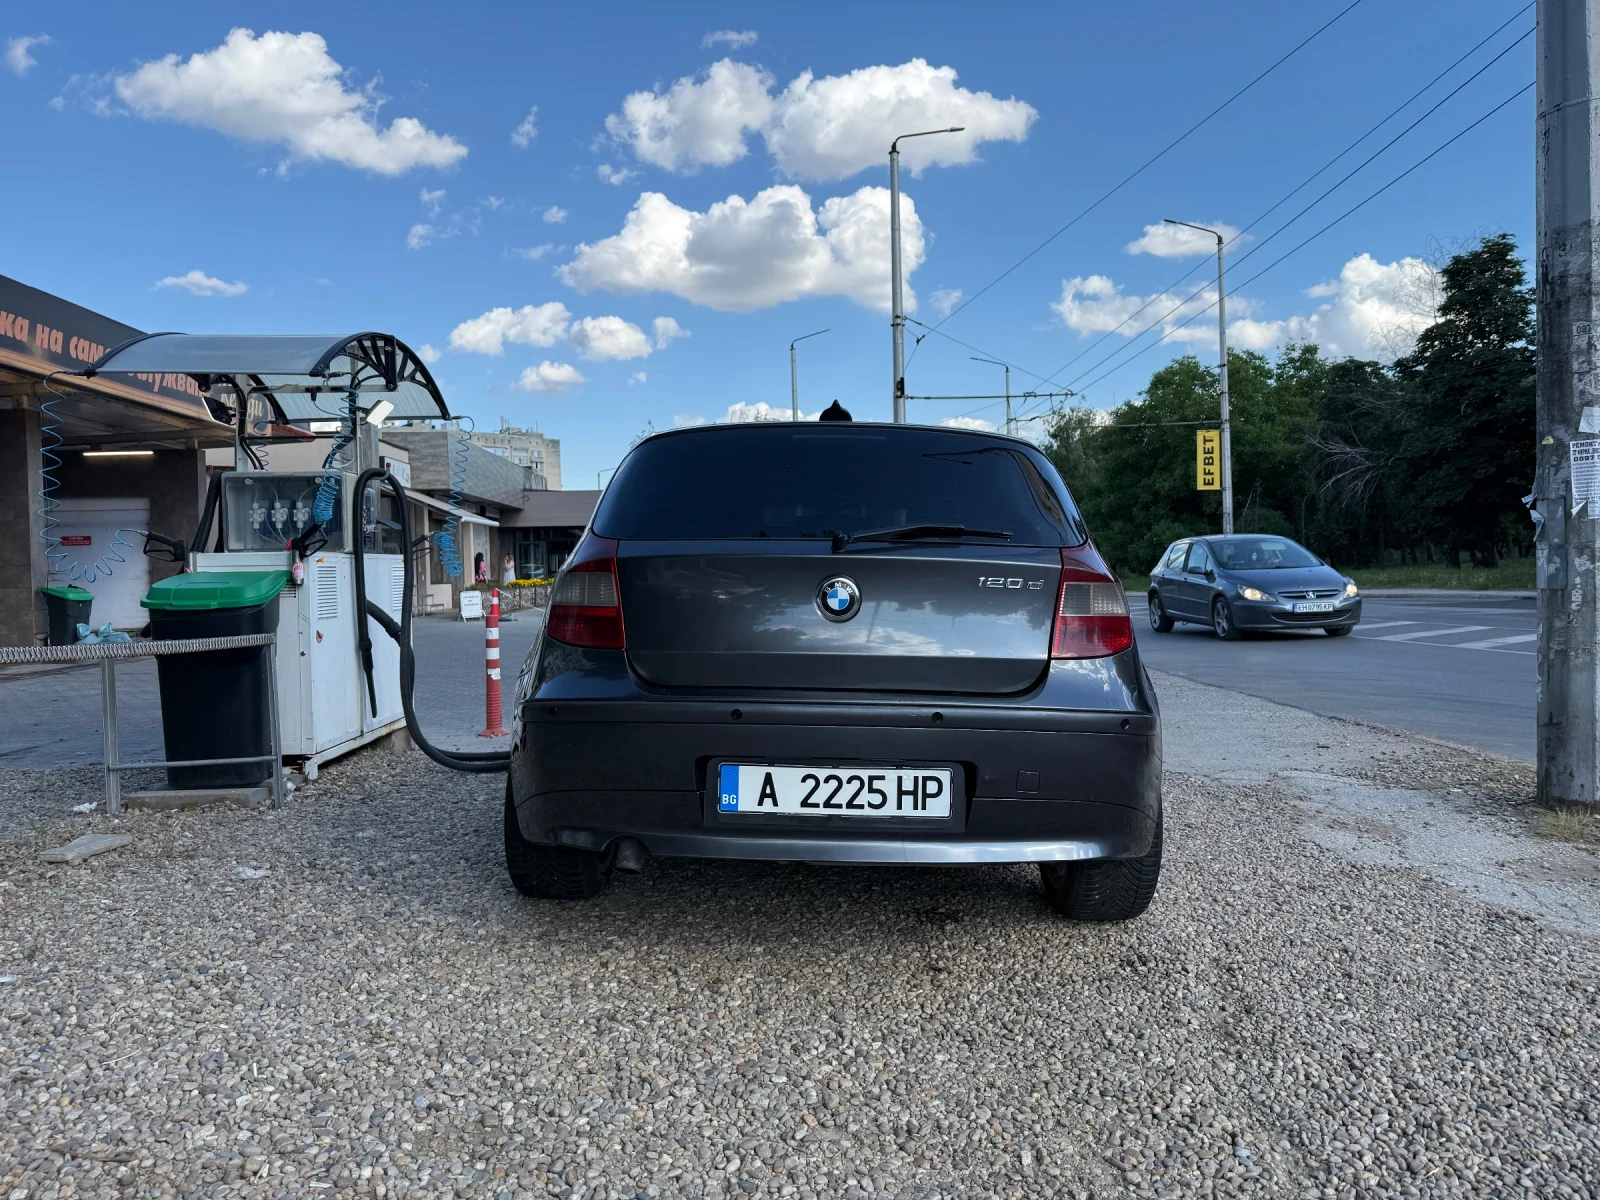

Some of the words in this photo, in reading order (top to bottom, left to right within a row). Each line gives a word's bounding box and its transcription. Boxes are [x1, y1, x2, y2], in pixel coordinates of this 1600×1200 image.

[35, 323, 63, 354] на
[1203, 435, 1214, 486] EFBET
[824, 582, 853, 593] BMW
[722, 794, 737, 805] BG
